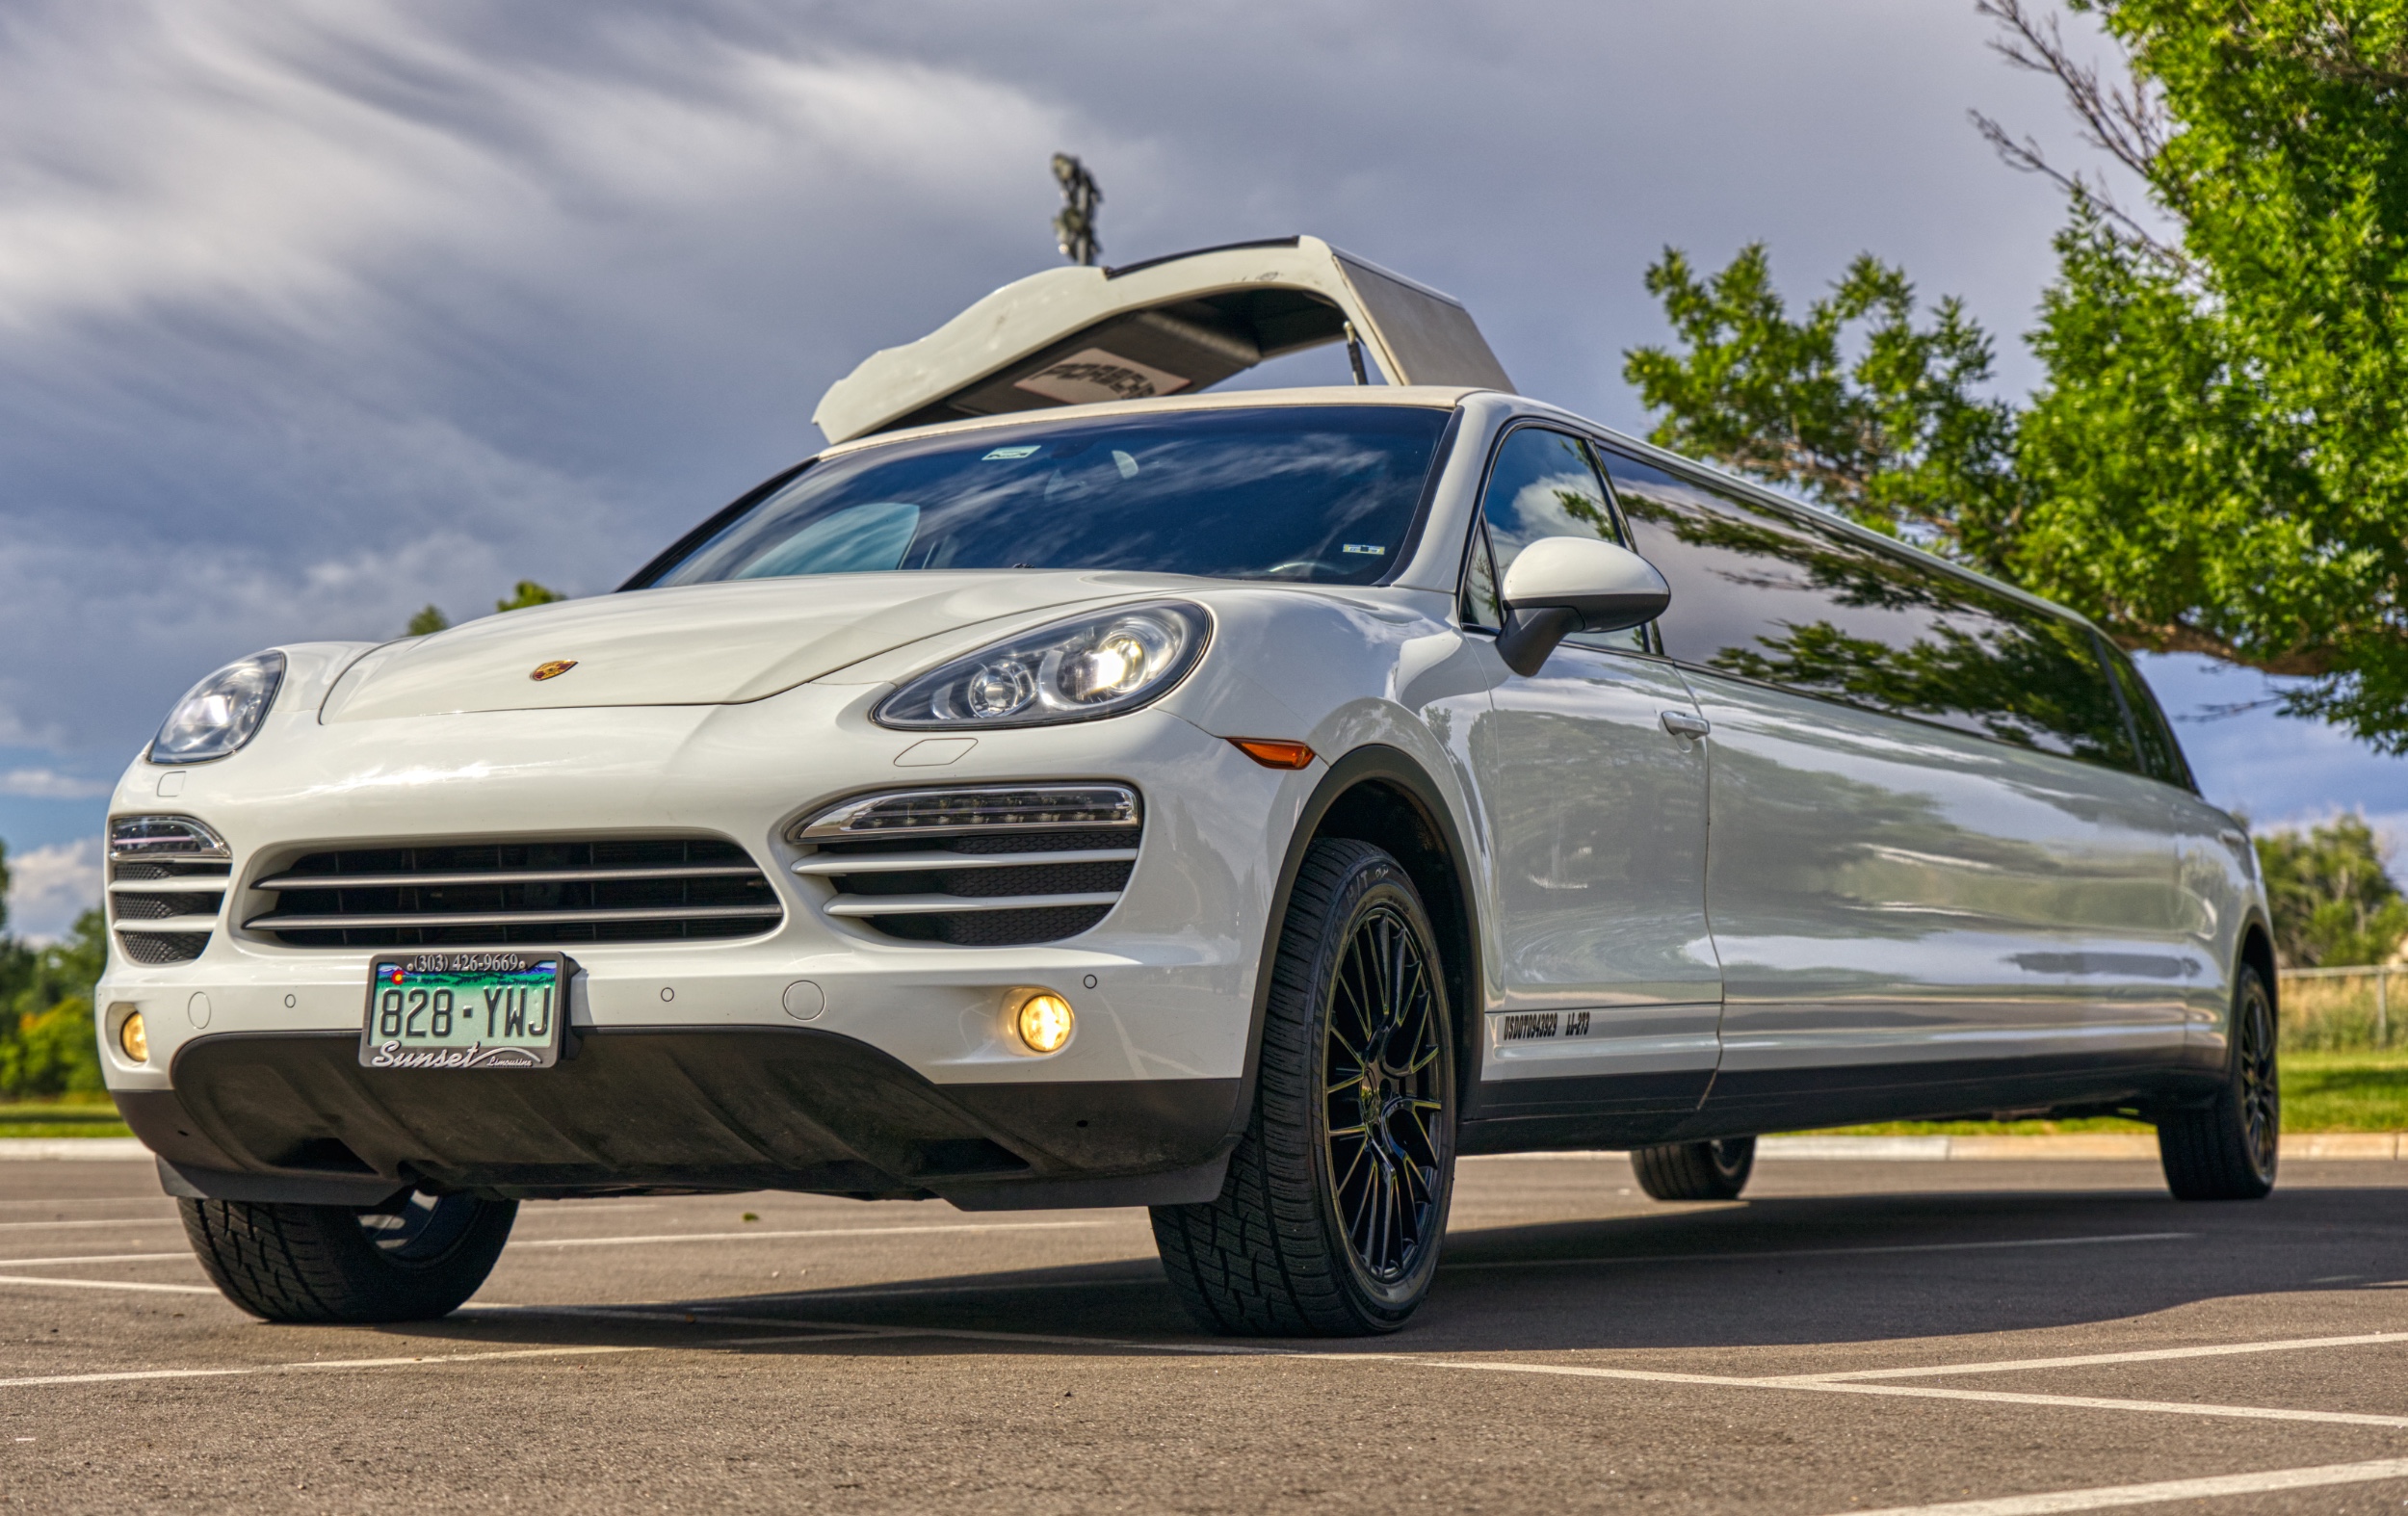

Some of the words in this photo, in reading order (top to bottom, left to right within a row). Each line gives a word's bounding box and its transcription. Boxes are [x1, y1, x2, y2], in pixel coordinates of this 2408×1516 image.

[414, 954, 449, 971] (303)
[452, 954, 519, 971] 426-9669
[372, 1039, 483, 1068] Sunset
[486, 1056, 534, 1067] Limousine
